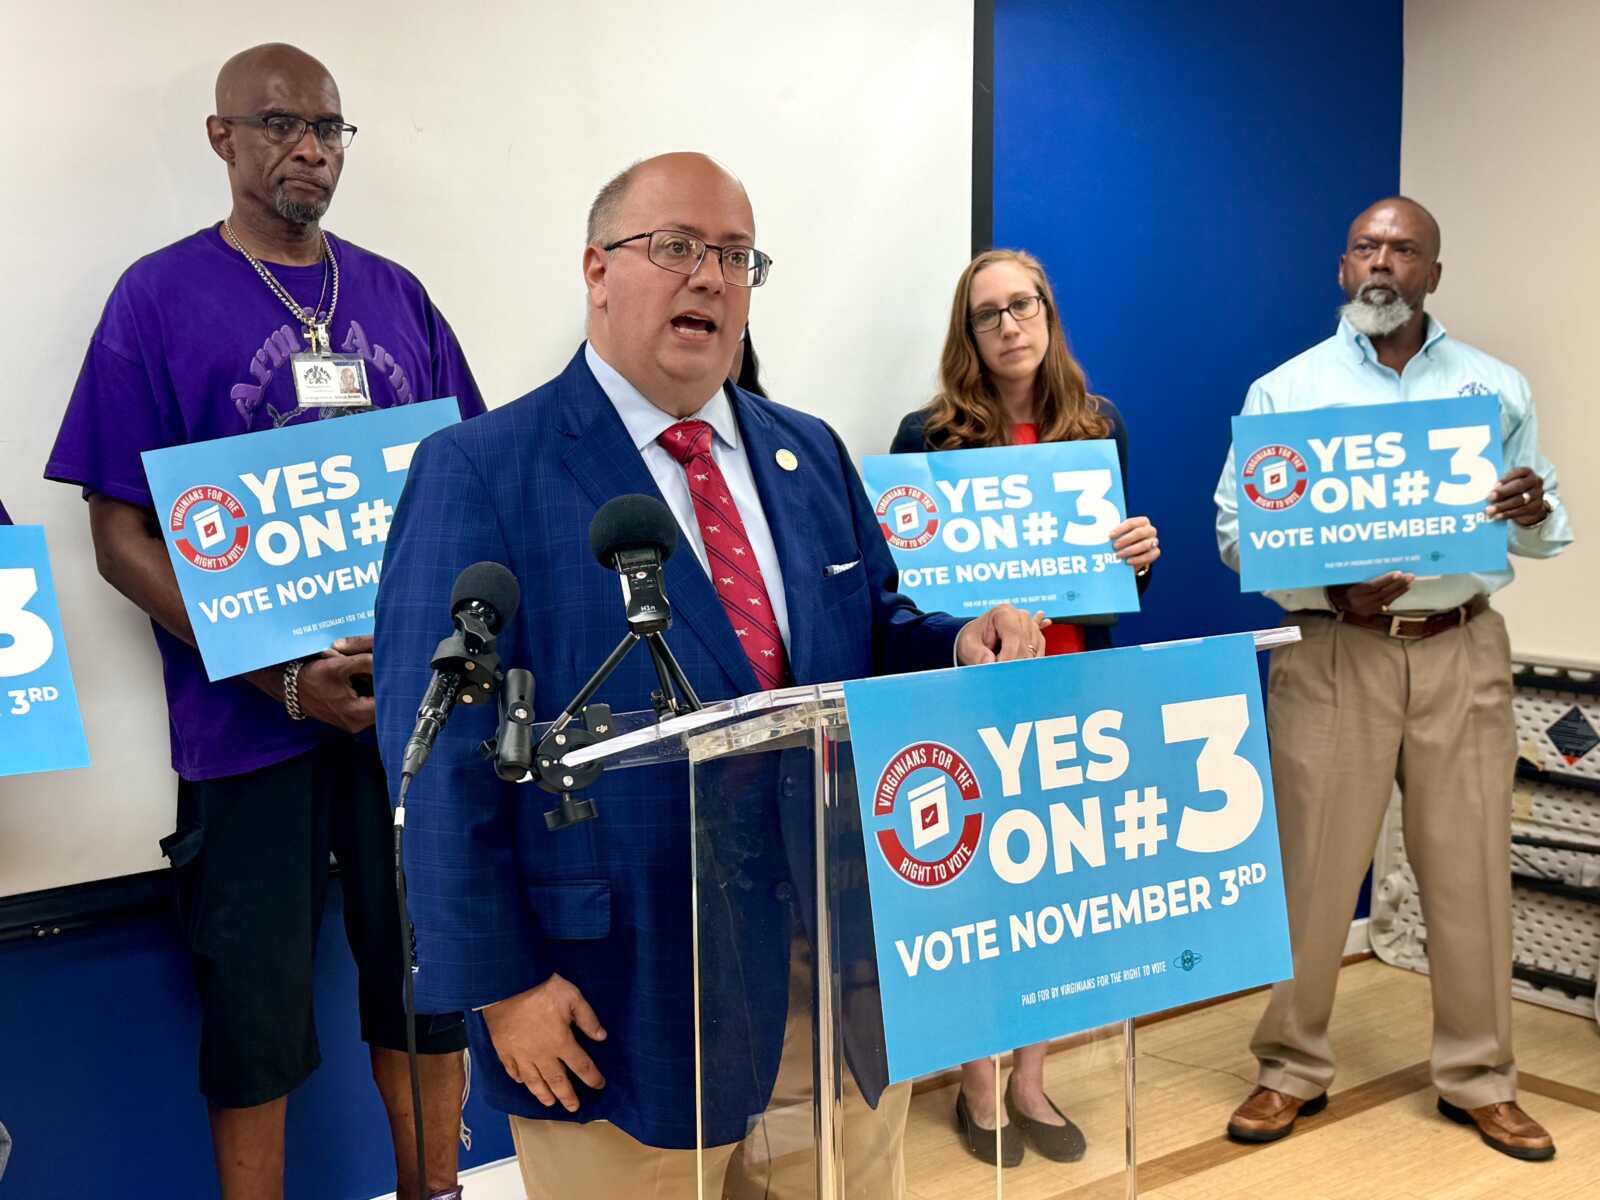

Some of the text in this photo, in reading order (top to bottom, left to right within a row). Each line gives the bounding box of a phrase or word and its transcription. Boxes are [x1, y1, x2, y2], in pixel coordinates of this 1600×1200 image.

[1308, 431, 1406, 473] YES
[239, 454, 360, 515] YES
[936, 474, 1033, 513] YES
[1310, 474, 1387, 514] ON
[173, 489, 240, 527] VIRGINIANS FOR THE
[255, 508, 347, 567] ON
[942, 514, 1018, 553] ON
[1250, 528, 1314, 550] VOTE
[1320, 516, 1456, 545] NOVEMBER
[193, 543, 244, 568] RIGHT TO VOTE
[956, 555, 1088, 583] NOVEMBER
[198, 559, 383, 624] VOTE NOVEM
[8, 686, 58, 715] 3RD
[977, 709, 1130, 797] YES
[878, 748, 974, 807] VIRGINIANS FOR THE
[988, 796, 1106, 885] ON
[899, 842, 972, 882] RIGHT TO VOTE
[895, 862, 1267, 977] VOTE NOVEMBER 3RD
[1021, 961, 1167, 1006] PAID FOR BY VIRGINIANS FOR THE RIGHT TO VOTE
